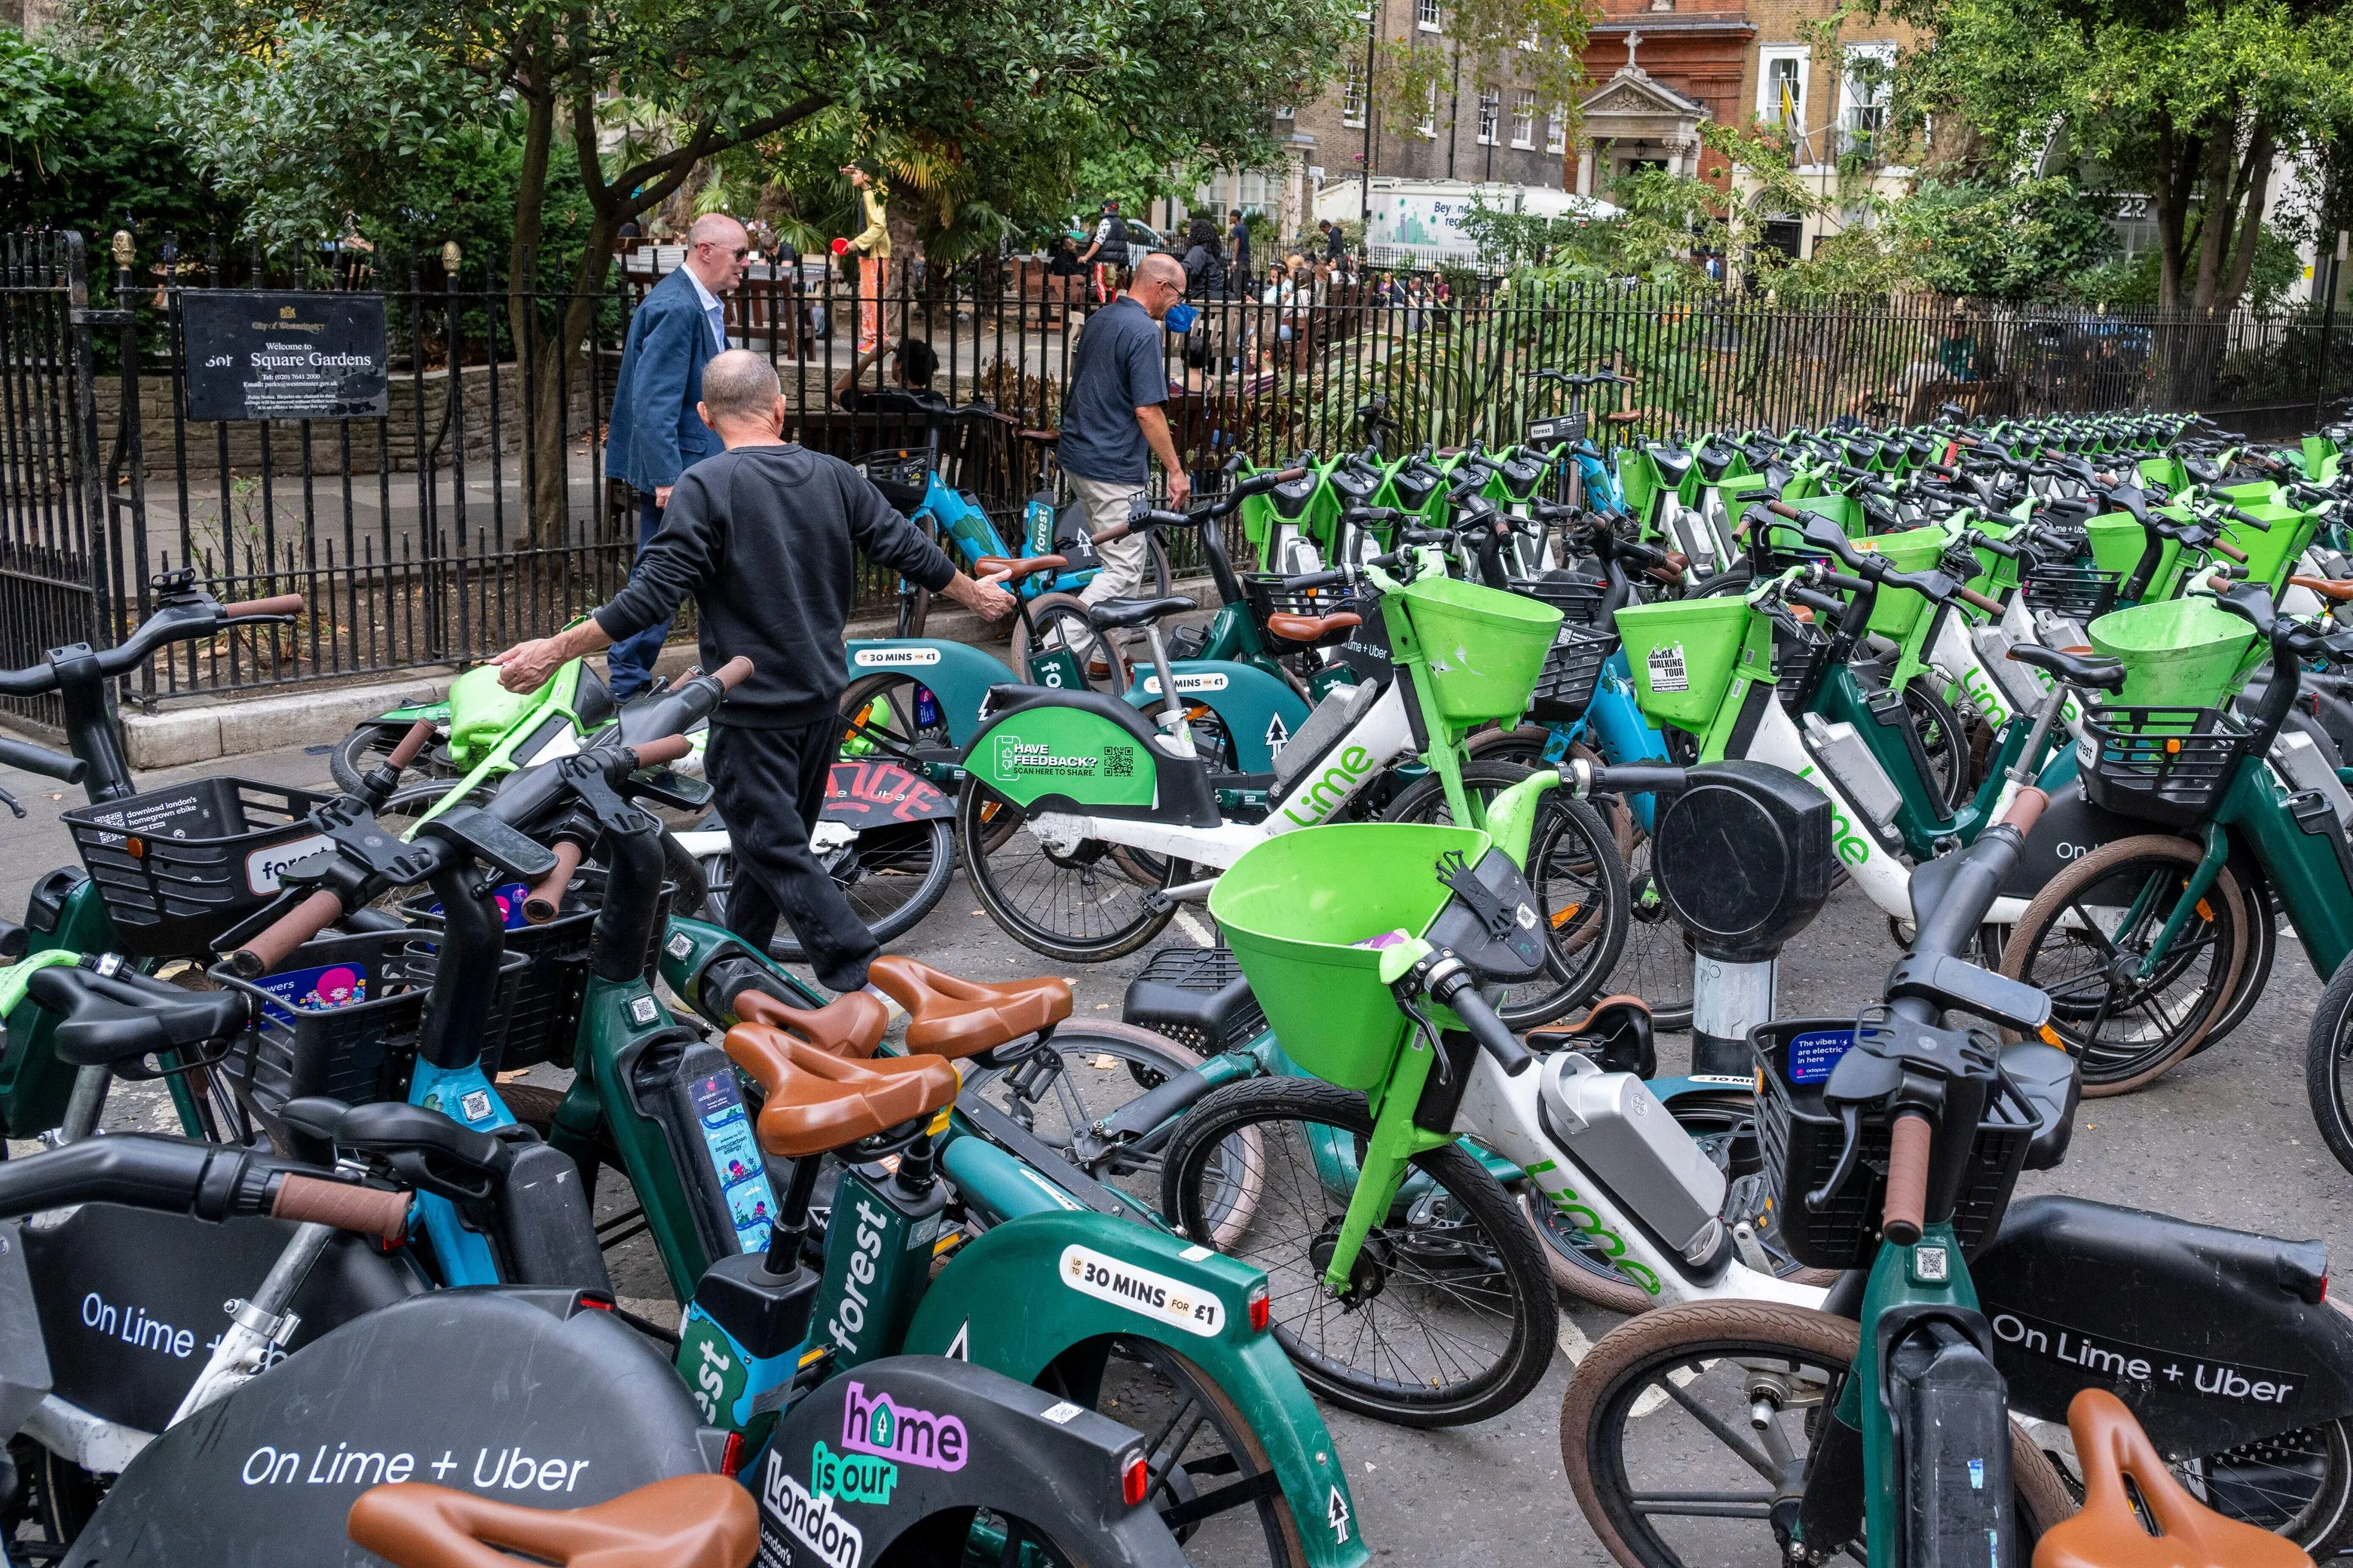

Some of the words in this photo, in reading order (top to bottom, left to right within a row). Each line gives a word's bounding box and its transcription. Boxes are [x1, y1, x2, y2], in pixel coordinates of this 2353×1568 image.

[252, 321, 267, 332] City
[269, 321, 278, 330] of
[266, 342, 302, 351] Welcome
[251, 352, 304, 370] Square
[309, 352, 372, 367] Gardens
[265, 380, 338, 388] parks@westminster.gov.uk
[1035, 509, 1048, 552] forest
[2074, 525, 2088, 534] Ube
[886, 653, 912, 662] MINS
[1348, 639, 1361, 653] Lime
[1363, 643, 1368, 653] +
[1369, 643, 1388, 659] Uber
[1649, 658, 1683, 668] WALKING
[1663, 668, 1684, 677] TOUR
[1174, 679, 1201, 687] MINS
[1214, 677, 1223, 686] £1
[1963, 665, 2006, 729] Lim
[1014, 744, 1049, 754] HAVE
[1014, 756, 1098, 768] FEEDBACK?
[1283, 746, 1374, 827] Lime
[126, 804, 164, 818] download
[165, 796, 197, 809] london's
[128, 809, 175, 826] homegrown
[176, 805, 197, 815] ebike
[2056, 842, 2087, 859] On
[262, 981, 295, 992] wers
[714, 1136, 747, 1153] zero-carbon
[720, 1136, 734, 1144] powered
[724, 1144, 742, 1155] energy
[1525, 1158, 1661, 1296] Lime
[1072, 1258, 1082, 1267] UP
[1072, 1267, 1080, 1275] TO
[829, 1200, 887, 1354] forest
[1084, 1263, 1110, 1288] 30
[1112, 1273, 1167, 1309] MINS
[1171, 1299, 1189, 1313] FOR
[83, 1292, 117, 1335] On
[121, 1307, 194, 1358] Lime
[1992, 1314, 2048, 1353] On
[2056, 1332, 2152, 1380] Lime
[2162, 1363, 2184, 1382] +
[2194, 1364, 2293, 1404] Uber
[694, 1340, 730, 1426] est
[242, 1445, 300, 1486] On
[307, 1441, 415, 1485] Lime
[430, 1450, 457, 1481] +
[473, 1447, 590, 1493] Uber
[815, 1450, 836, 1490] is
[842, 1463, 891, 1495] our
[766, 1460, 857, 1568] London
[761, 1523, 791, 1566] London's
